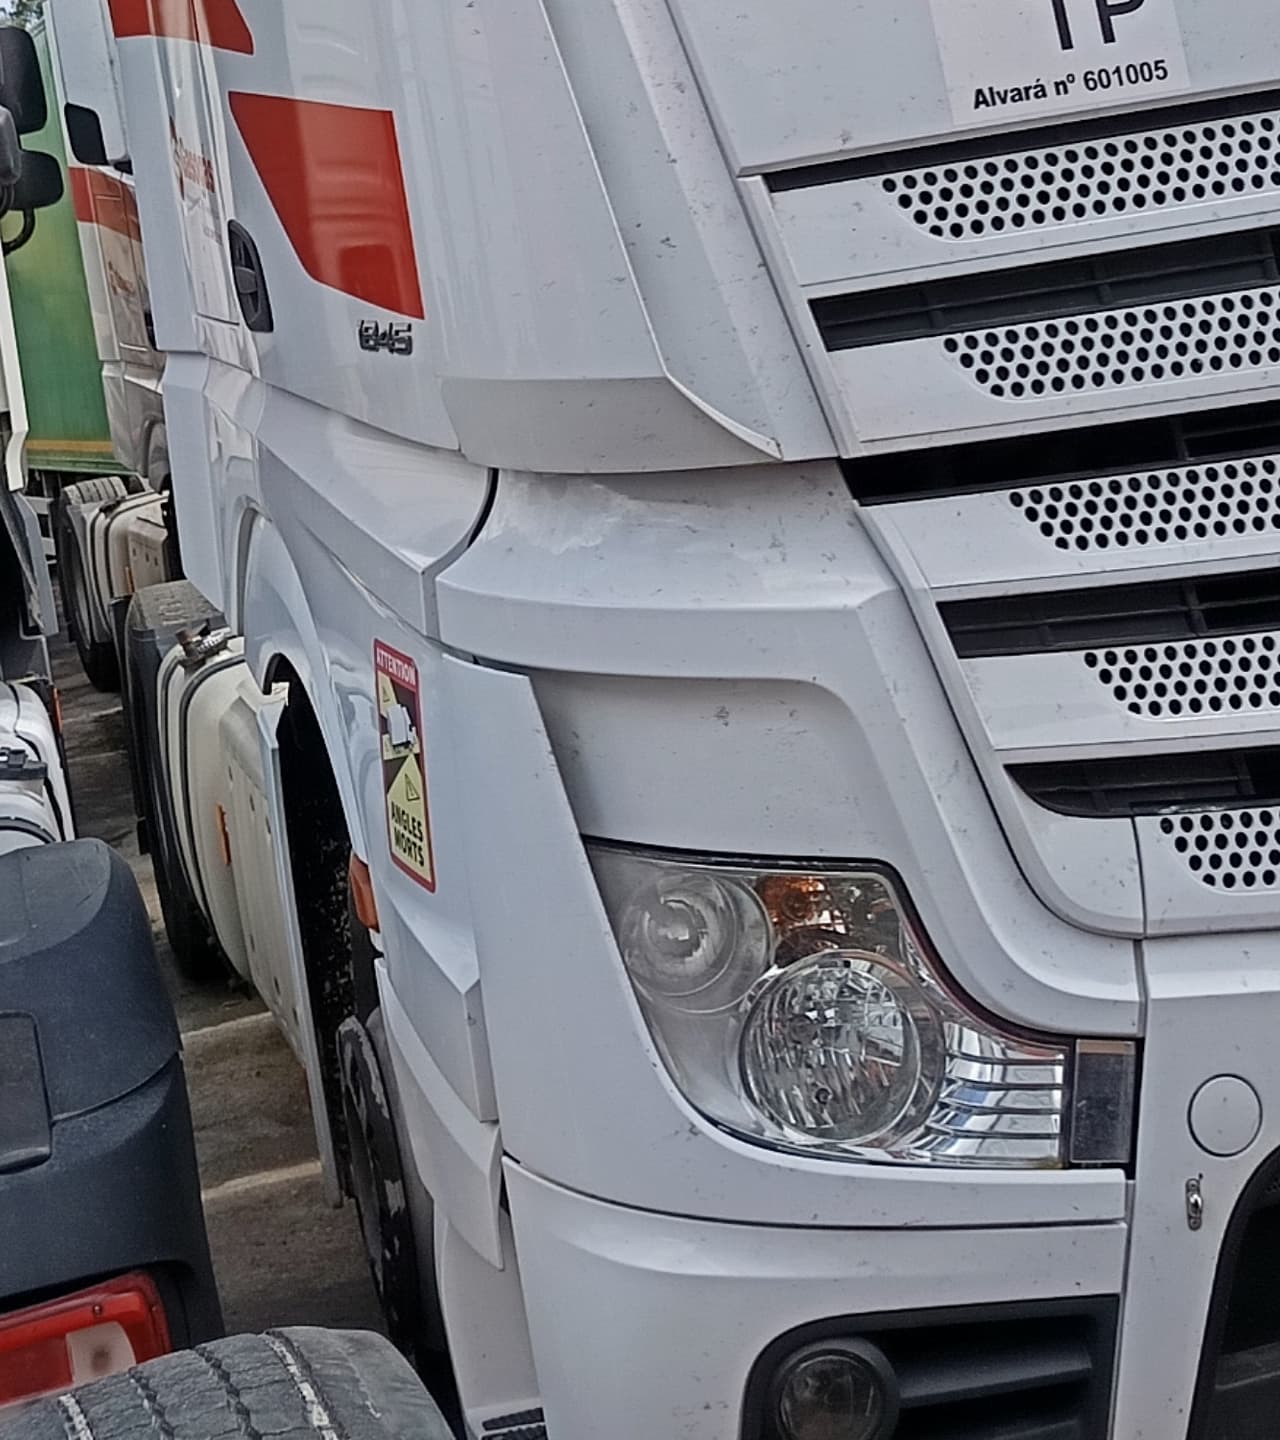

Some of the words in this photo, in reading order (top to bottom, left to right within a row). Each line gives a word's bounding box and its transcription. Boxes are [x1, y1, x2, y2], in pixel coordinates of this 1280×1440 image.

[973, 78, 1048, 111] Alvará
[1082, 59, 1169, 92] 601005
[376, 647, 418, 686] ATTENTION
[391, 800, 424, 843] ANGLES
[394, 826, 426, 868] MORTS
